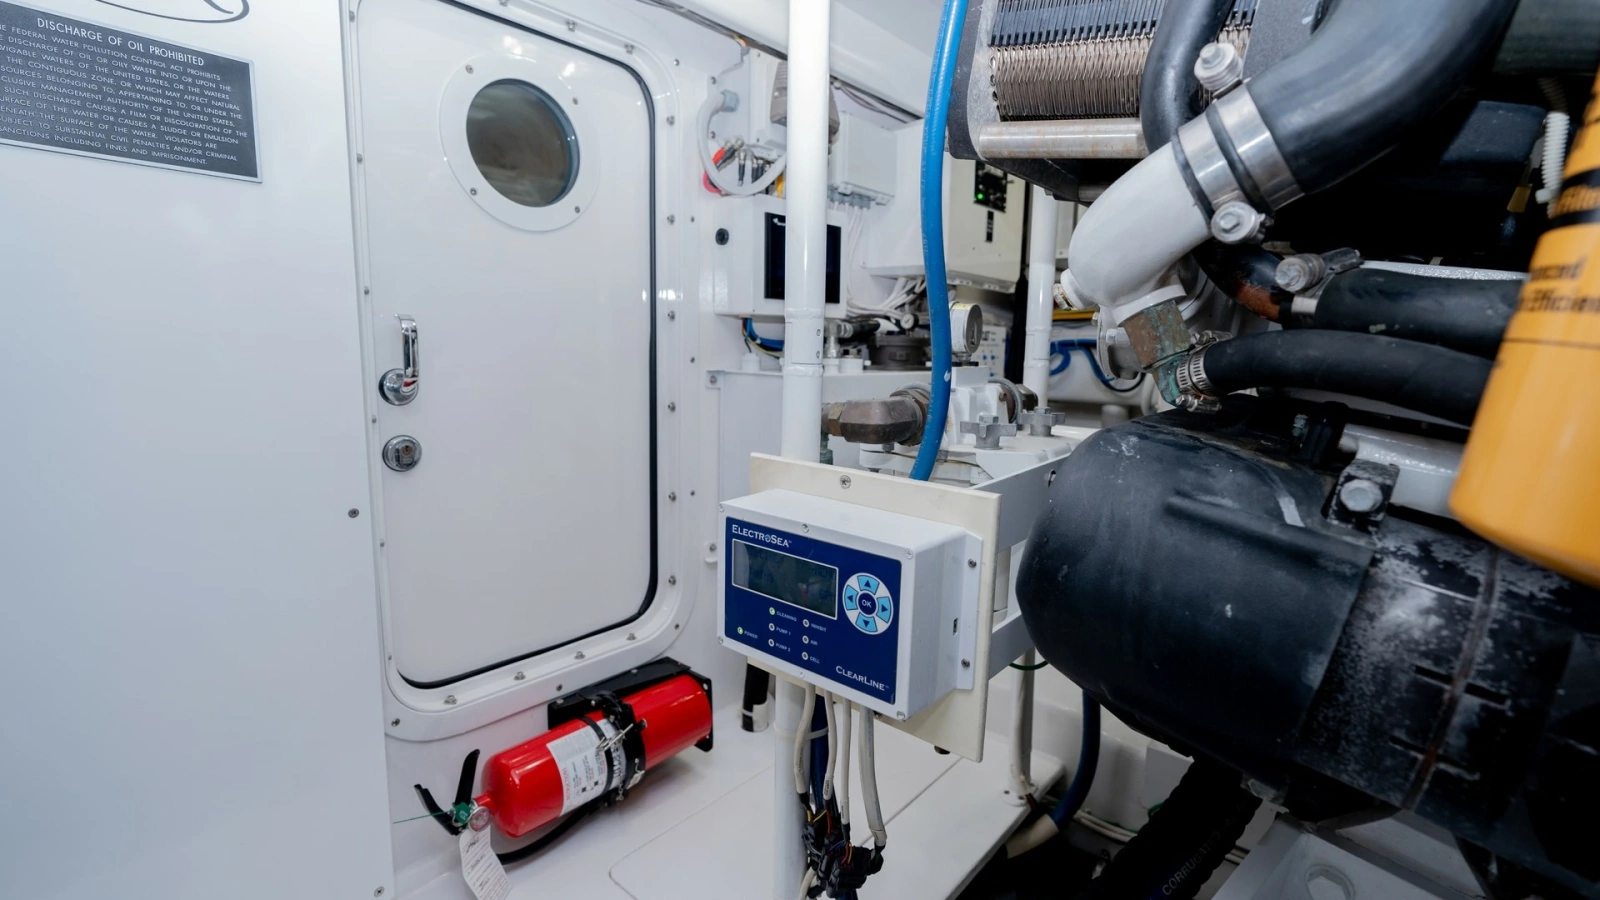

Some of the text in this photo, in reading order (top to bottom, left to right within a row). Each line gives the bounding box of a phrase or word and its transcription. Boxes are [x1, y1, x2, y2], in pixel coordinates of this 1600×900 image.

[8, 36, 58, 53] DISCHARGE
[63, 48, 73, 56] OF
[78, 52, 91, 60] OIL
[111, 59, 127, 68] OILY
[131, 64, 156, 74] WASTE
[160, 70, 178, 79] INTO
[195, 78, 215, 87] UPON
[11, 26, 46, 40] FEDERAL
[51, 36, 78, 47] WATER
[83, 43, 126, 58] POLLUTION
[131, 54, 166, 67] CONTROL
[170, 63, 182, 71] ACT
[187, 67, 220, 80] PROHIBITS
[37, 17, 204, 66] DISCHARGE OF OIL PROHIBITED
[1, 65, 41, 79] SOURCES
[46, 74, 97, 90] BELONGING
[118, 89, 172, 105] APPERTAINING
[204, 107, 226, 116] UNDER
[1, 75, 35, 87] CLUSIVE
[40, 83, 101, 100] MANAGEMENT
[106, 96, 148, 109] AUTHORITY
[183, 111, 208, 121] UNITED
[6, 56, 22, 65] THE
[27, 60, 86, 78] CONTIGUOUS
[135, 83, 161, 94] WHICH
[165, 90, 180, 98] MAY
[183, 93, 208, 103] AFFECT
[211, 99, 239, 110] NATURAL
[41, 53, 73, 66] WATERS
[78, 61, 89, 69] OF
[94, 65, 108, 73] THE
[112, 69, 140, 80] UNITED
[188, 85, 200, 93] THE
[204, 89, 229, 99] WATERS
[1, 105, 34, 117] ENEATH
[39, 112, 55, 120] THE
[60, 116, 93, 127] SURFACE
[113, 125, 127, 133] THE
[164, 134, 201, 146] VIOLATORS
[4, 86, 28, 96] SUCH
[33, 92, 81, 106] DISCHARGE
[86, 102, 116, 112] CAUSES
[129, 110, 146, 118] FILM
[164, 116, 219, 132] DISCOLORATION
[53, 105, 67, 113] THE
[72, 109, 98, 119] WATER
[118, 117, 147, 127] CAUSES
[160, 125, 186, 134] SLUDGE
[204, 133, 238, 143] EMULSION
[0, 115, 32, 126] UBJECT
[55, 125, 105, 139] SUBSTANTIAL
[110, 134, 128, 142] CIVIL
[132, 138, 169, 149] PENALTIES
[173, 145, 202, 155] AND/OR
[205, 151, 236, 161] CRIMINAL
[54, 135, 100, 147] INCLUDING
[105, 143, 127, 151] FINES
[131, 147, 147, 155] AND
[862, 599, 872, 608] OK
[744, 630, 758, 639] POWER
[776, 627, 788, 635] PUMP
[776, 642, 788, 650] PUMP
[810, 656, 820, 664] CELL
[1162, 830, 1221, 896] CORRUGATED
